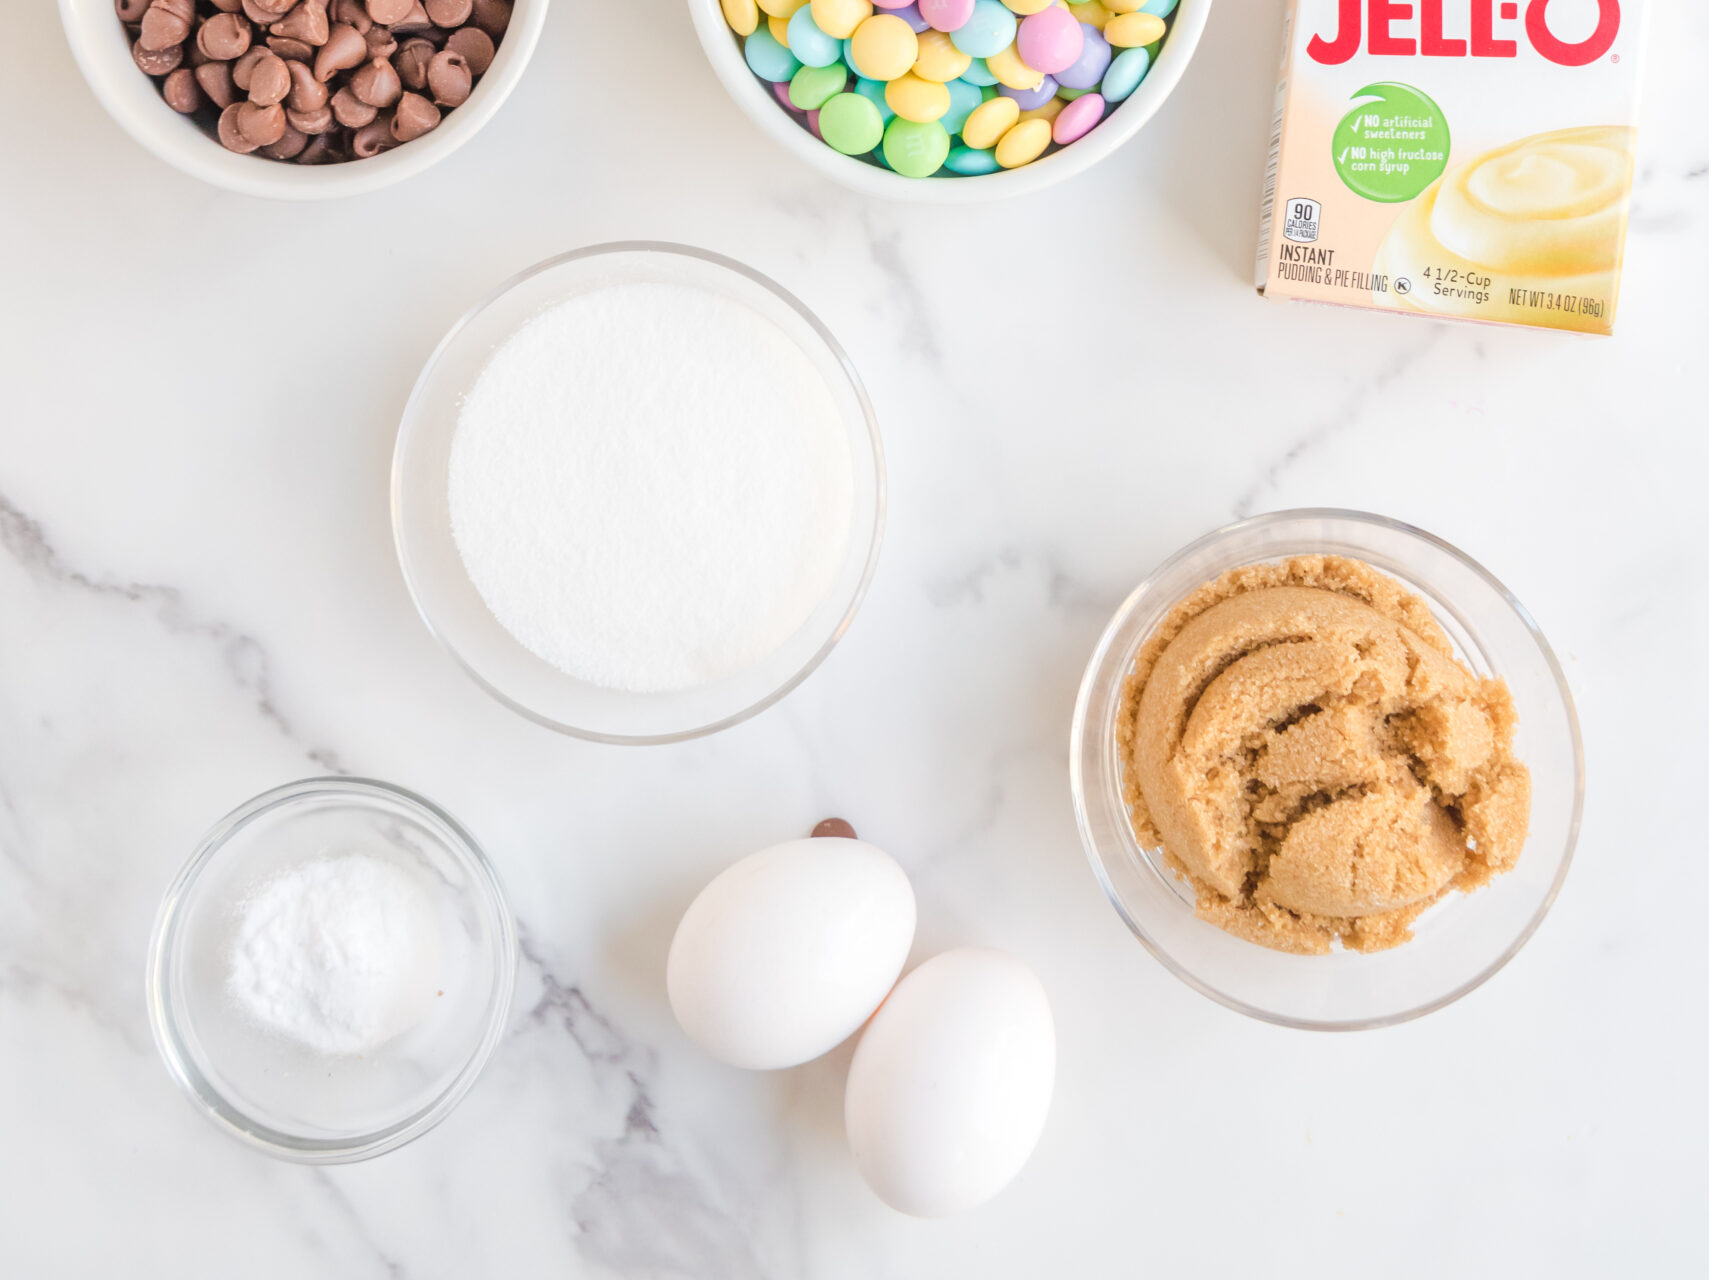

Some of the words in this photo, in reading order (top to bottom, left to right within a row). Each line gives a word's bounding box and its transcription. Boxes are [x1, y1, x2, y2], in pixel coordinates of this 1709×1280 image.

[1364, 114, 1380, 127] NO
[1383, 115, 1433, 128] artificial
[1364, 128, 1426, 140] sweeteners
[1351, 147, 1367, 159] NO
[1370, 148, 1395, 163] high
[1398, 148, 1444, 160] fructose
[1351, 162, 1376, 171] corn
[1379, 162, 1410, 175] syrup
[1294, 203, 1313, 221] 90
[1287, 219, 1317, 231] CALORIES
[1280, 243, 1335, 266] INSTANT
[1278, 261, 1323, 284] PUDDING
[1324, 267, 1332, 285] &
[1334, 269, 1350, 288] PIE
[1351, 271, 1388, 293] FILLING
[1423, 266, 1431, 279] 4
[1435, 267, 1491, 290] 1/2-Cup
[1433, 282, 1490, 305] Servings
[1508, 287, 1527, 306] NET
[1529, 290, 1546, 308] WT
[1546, 292, 1562, 311] 3.4
[1563, 294, 1577, 313] OZ
[1578, 297, 1605, 319] (96g)
